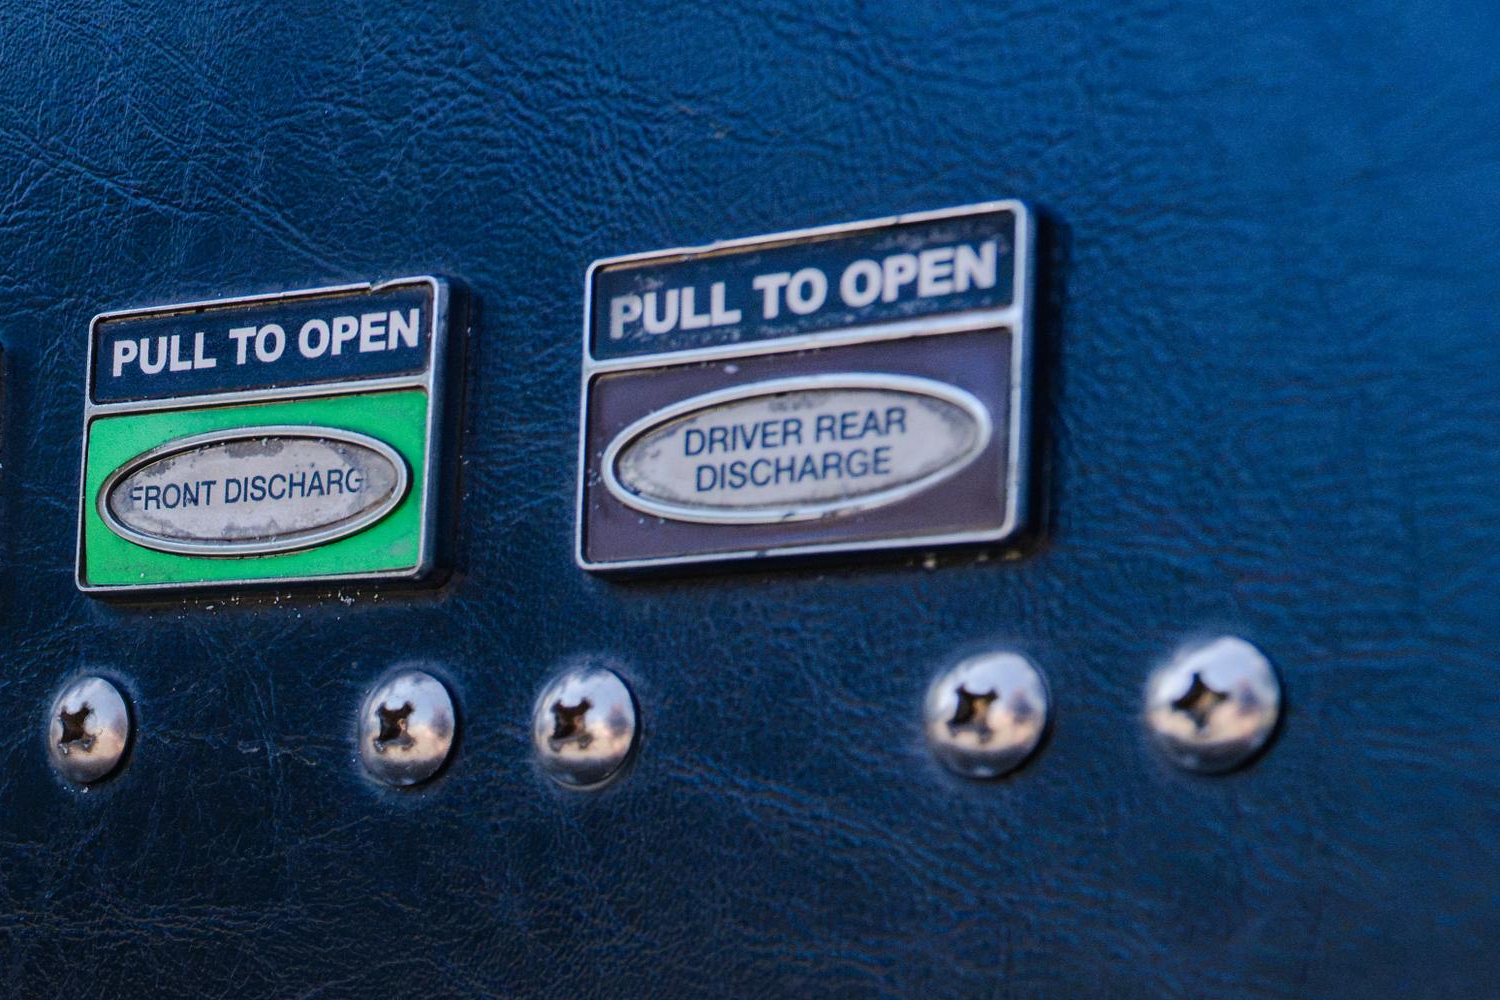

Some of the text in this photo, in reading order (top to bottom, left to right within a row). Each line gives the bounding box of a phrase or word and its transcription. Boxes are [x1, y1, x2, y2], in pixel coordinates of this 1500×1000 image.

[609, 240, 997, 340] PULL TO OPEN
[112, 308, 421, 377] PULL TO OPEN
[683, 406, 907, 458] DRIVER REAR
[695, 445, 893, 492] DISCHARGE
[130, 480, 217, 510] FRONT
